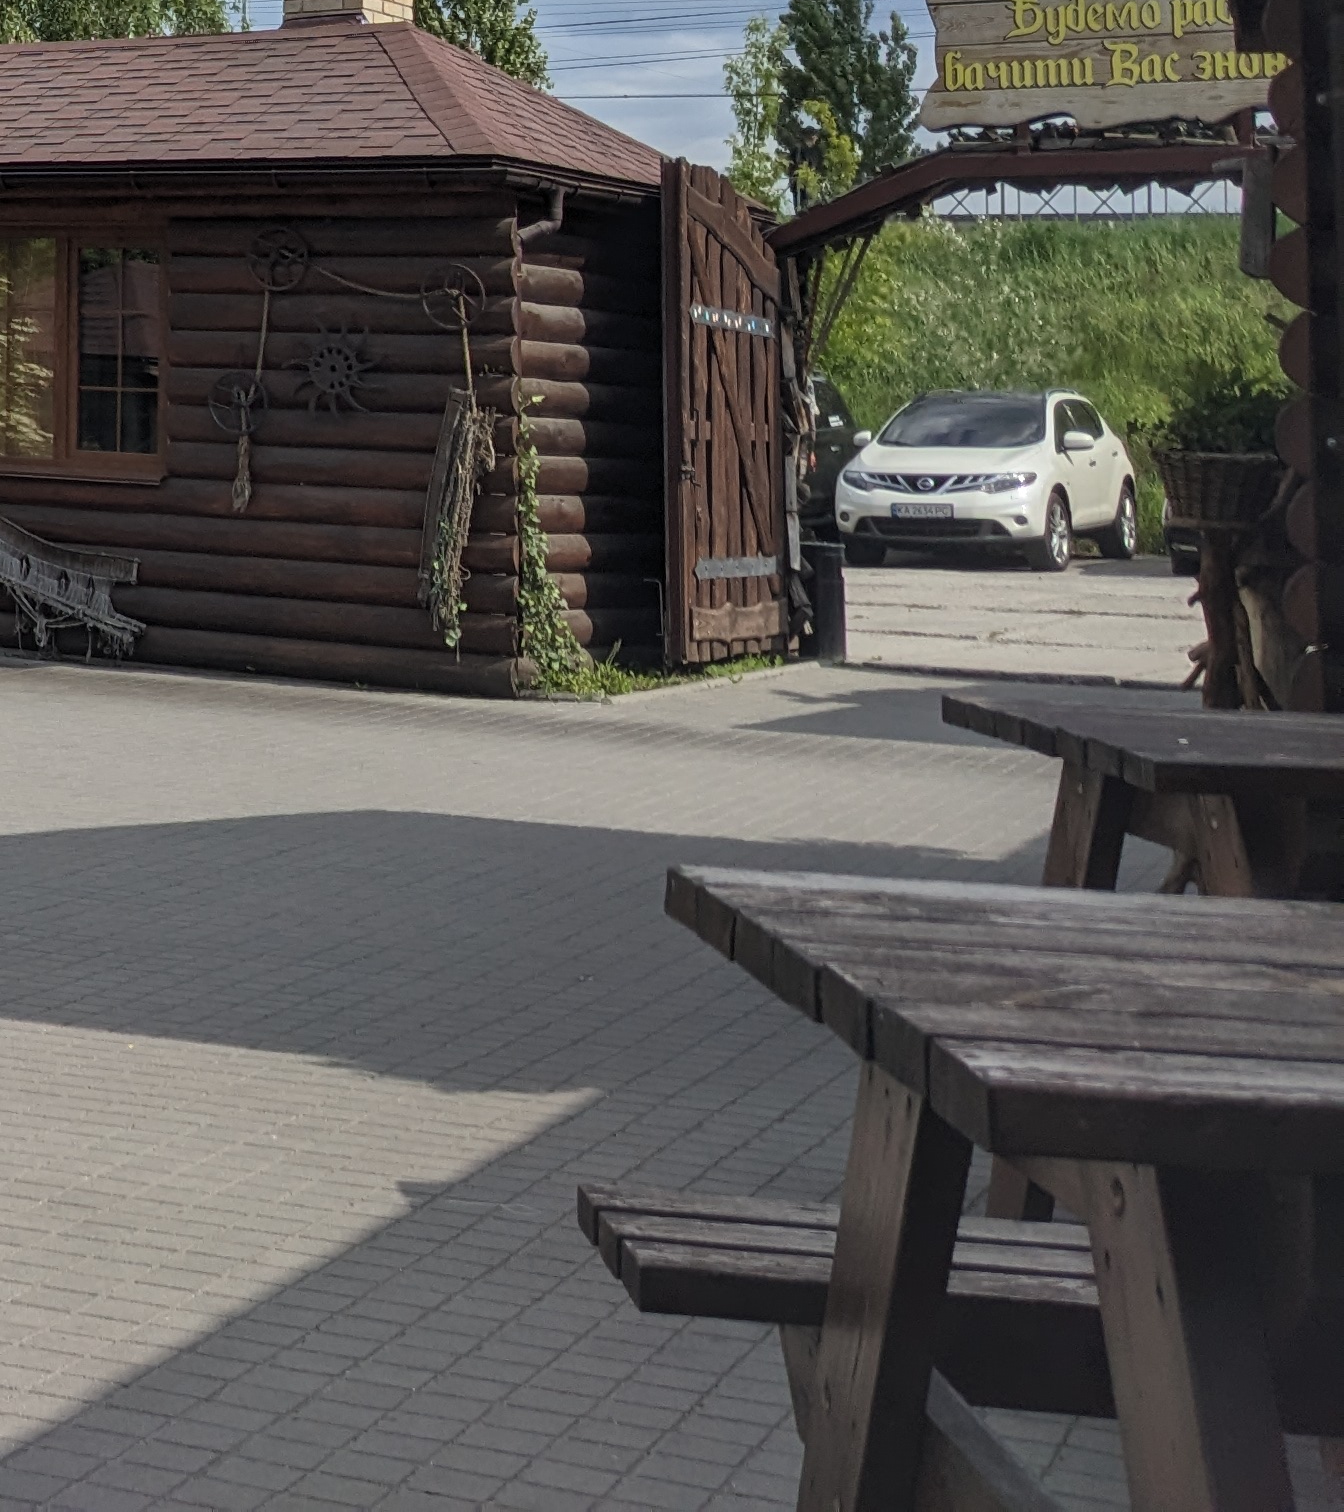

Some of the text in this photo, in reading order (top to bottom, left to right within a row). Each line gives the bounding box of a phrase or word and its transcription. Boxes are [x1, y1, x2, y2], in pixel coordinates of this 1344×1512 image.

[945, 41, 1293, 91] бачити Вас знов
